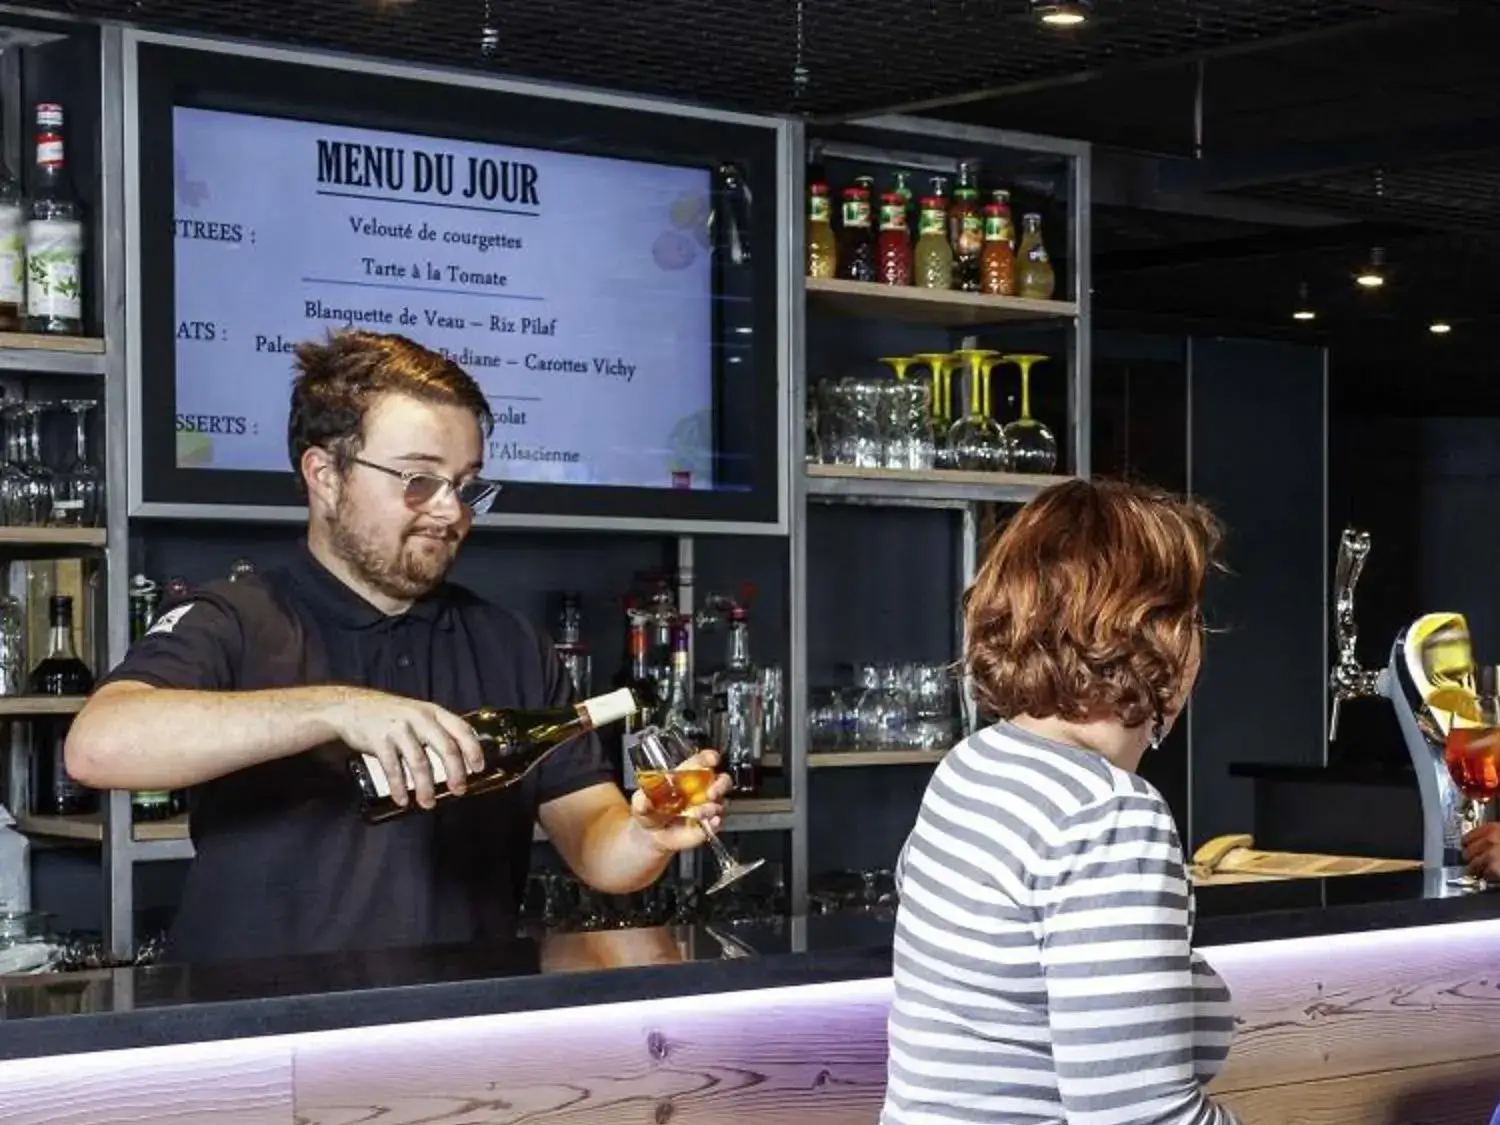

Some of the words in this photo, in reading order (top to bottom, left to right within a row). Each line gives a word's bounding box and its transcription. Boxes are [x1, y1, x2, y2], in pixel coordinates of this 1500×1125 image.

[316, 139, 405, 191] MENU
[412, 149, 455, 197] DU
[463, 156, 541, 206] JOUR
[173, 219, 243, 243] TREES
[349, 216, 413, 239] Velouté
[417, 222, 437, 241] de
[443, 231, 522, 252] courgettes
[361, 257, 406, 278] Tarte
[412, 263, 421, 279] à
[427, 261, 441, 281] la
[446, 264, 508, 286] Tomate
[304, 300, 394, 328] Blanquette
[399, 306, 418, 325] de
[424, 309, 465, 330] Veau
[490, 314, 515, 333] Riz
[521, 316, 558, 337] Pilaf
[525, 353, 588, 374] Carottes
[592, 357, 636, 382] Vichy
[489, 441, 580, 464] l'Alsacienne
